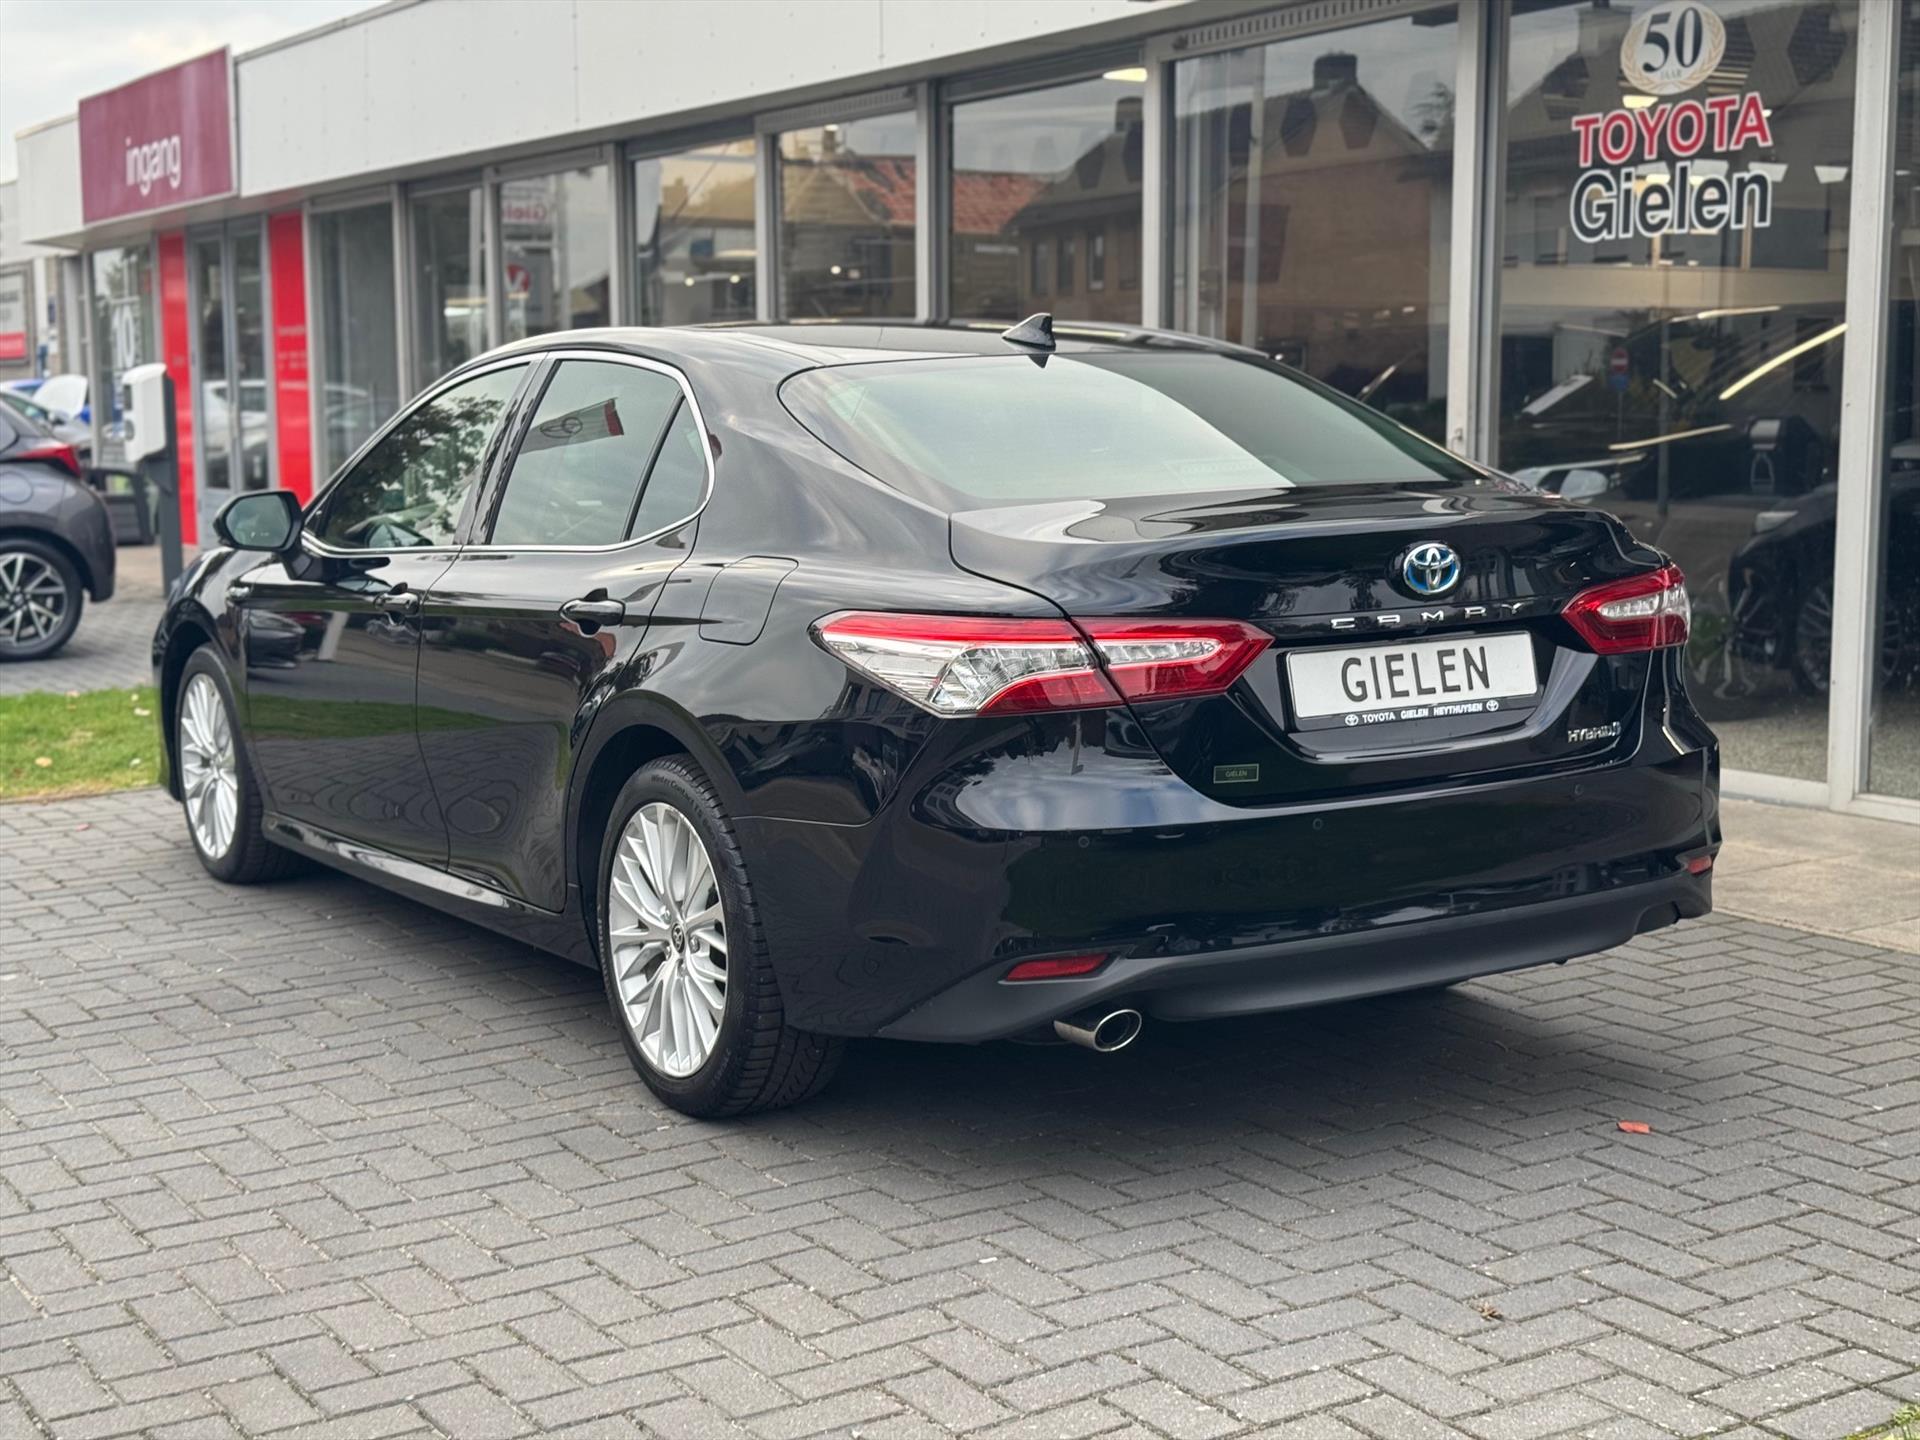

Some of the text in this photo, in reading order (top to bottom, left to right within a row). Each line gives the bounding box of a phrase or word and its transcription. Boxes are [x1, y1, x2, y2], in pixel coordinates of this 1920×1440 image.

[1642, 7, 1704, 73] 50
[1572, 91, 1773, 168] TOYOTA
[125, 134, 181, 197] ingang
[1570, 161, 1773, 243] Gielen
[1330, 602, 1526, 630] CAMRY
[1341, 645, 1491, 702] GIELEN
[1362, 703, 1483, 724] TOYOTA GIELEN HEYTHUYSEN
